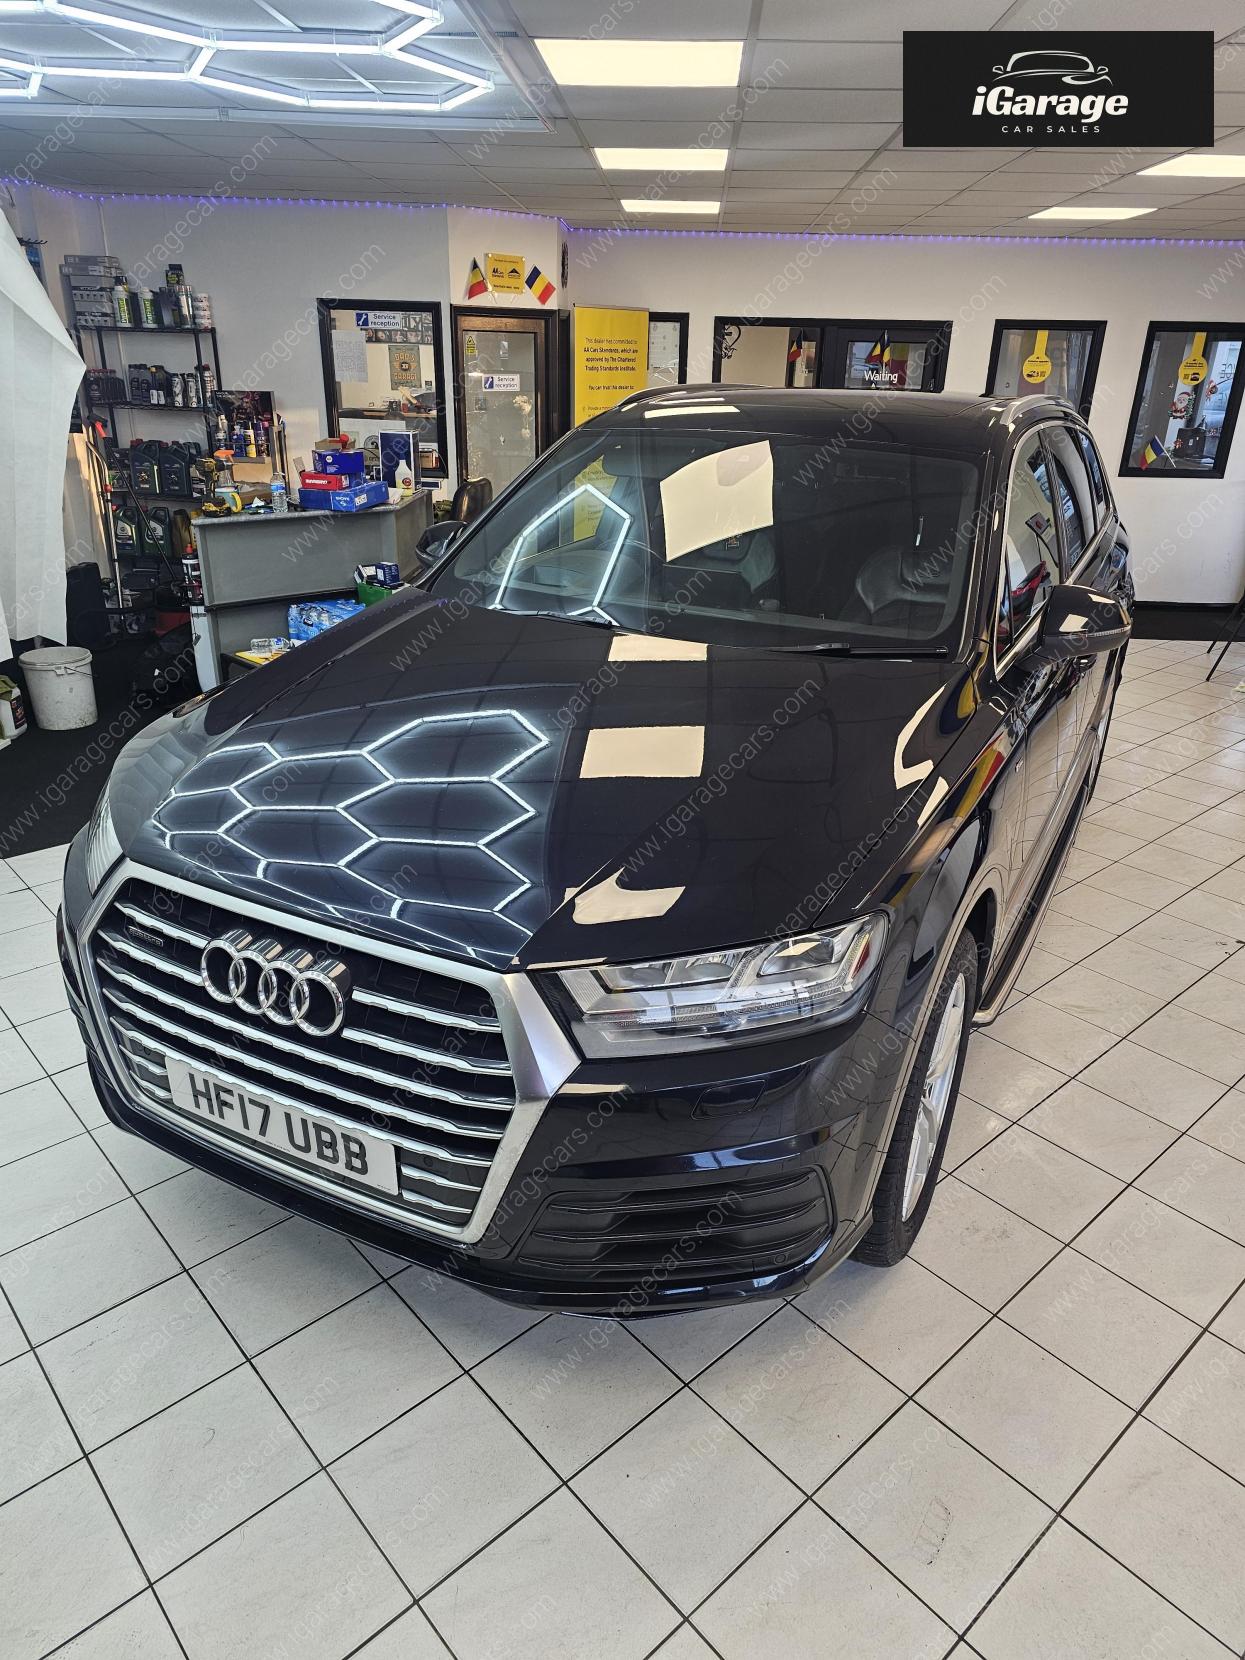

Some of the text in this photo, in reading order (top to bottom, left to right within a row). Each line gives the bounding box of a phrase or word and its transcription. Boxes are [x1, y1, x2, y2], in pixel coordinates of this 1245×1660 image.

[864, 370, 898, 383] Waiting
[188, 1072, 369, 1176] HF17 UBB
